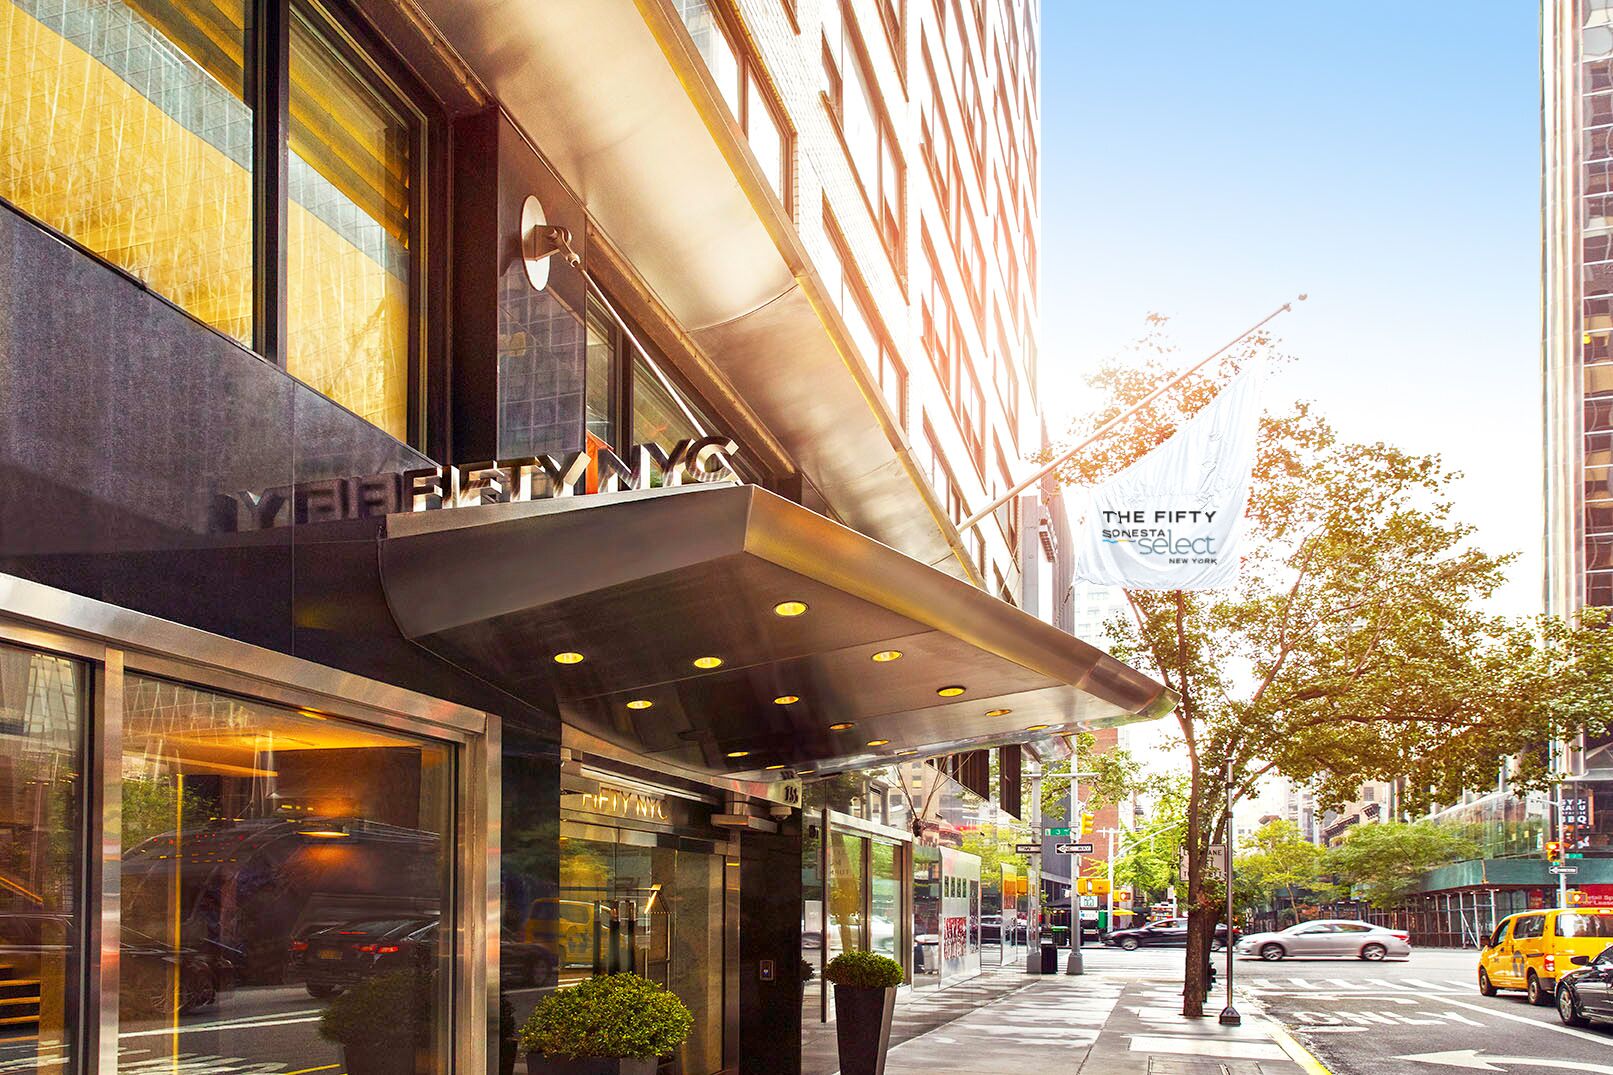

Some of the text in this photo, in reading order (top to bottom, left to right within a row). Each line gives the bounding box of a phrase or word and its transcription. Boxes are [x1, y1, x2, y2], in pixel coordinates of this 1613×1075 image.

[403, 435, 740, 513] FIFTY NYC
[1103, 510, 1217, 524] THE FIFTY
[1102, 528, 1166, 539] SONESTA
[1138, 528, 1217, 555] select
[1191, 557, 1218, 565] YORK
[582, 786, 668, 820] FIFTY NYC
[1293, 1011, 1488, 1027] ONLY
